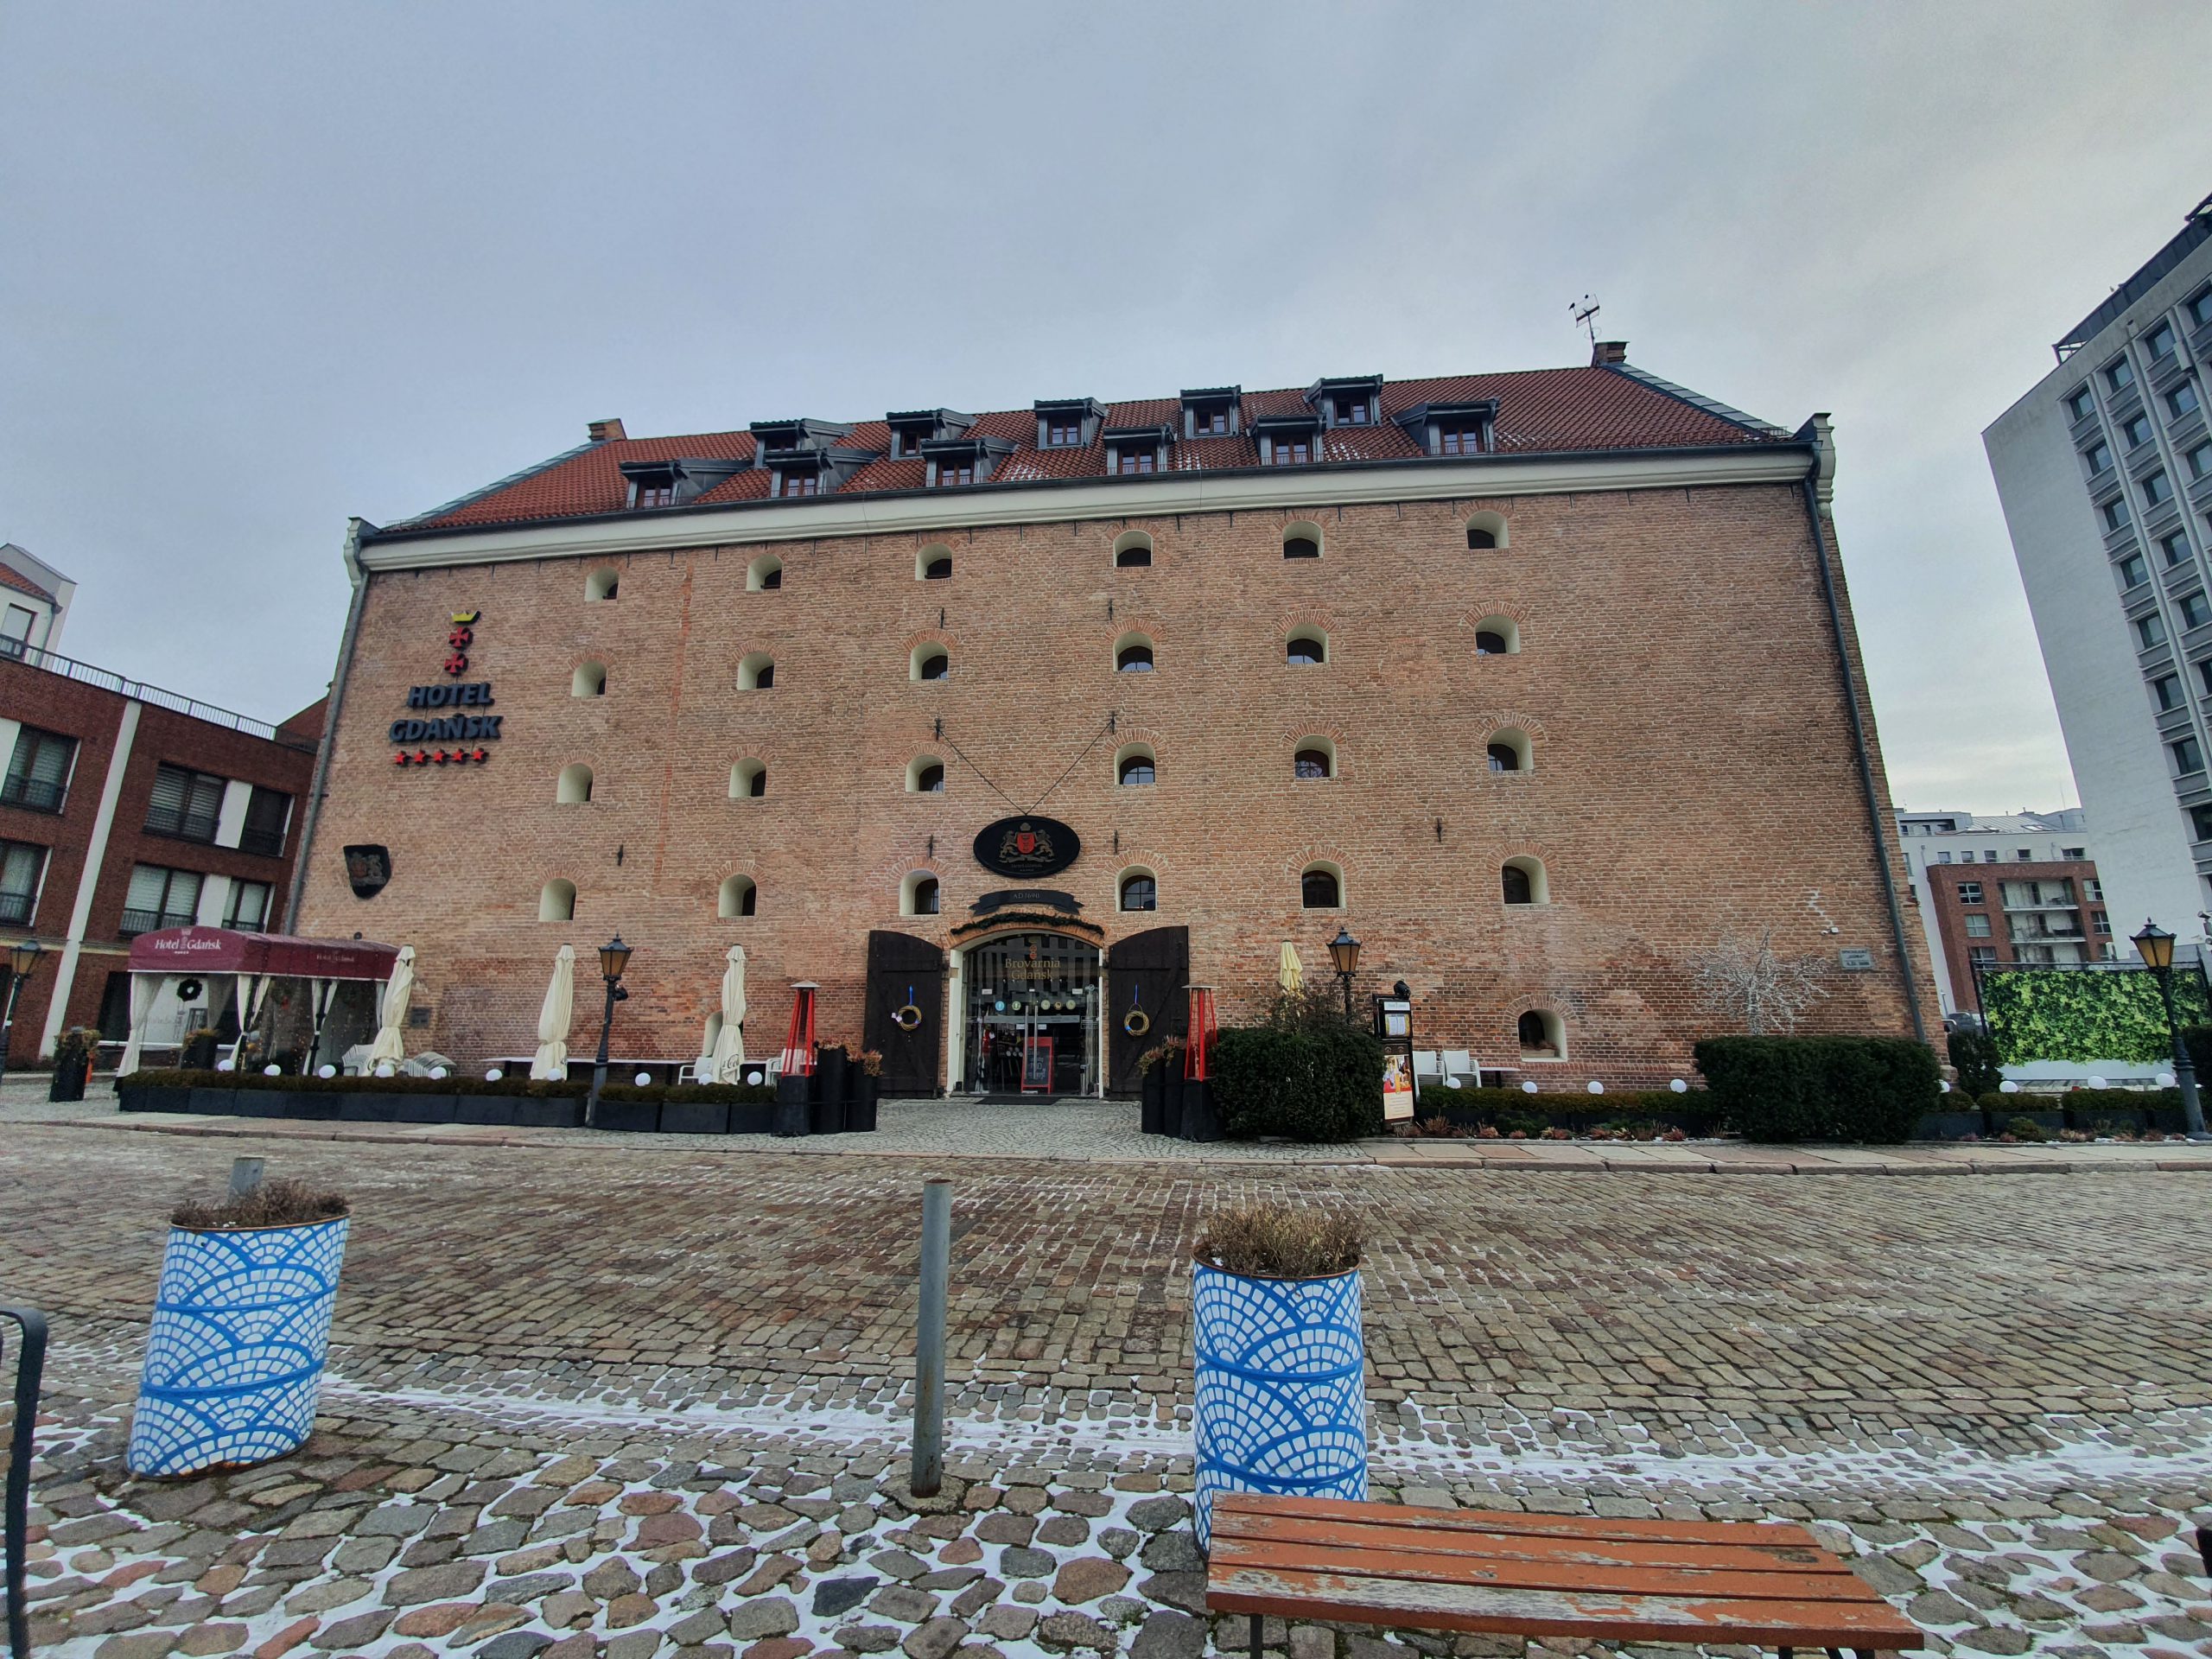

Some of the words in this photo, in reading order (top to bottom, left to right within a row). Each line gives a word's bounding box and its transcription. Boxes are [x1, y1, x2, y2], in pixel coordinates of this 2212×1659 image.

[407, 682, 495, 709] HOTEL
[389, 713, 504, 743] GDAŃSK
[155, 938, 180, 950] Hotel
[187, 938, 222, 950] Gdańsk
[1005, 957, 1061, 968] Brovarnia
[1011, 969, 1053, 980] Gdańsk
